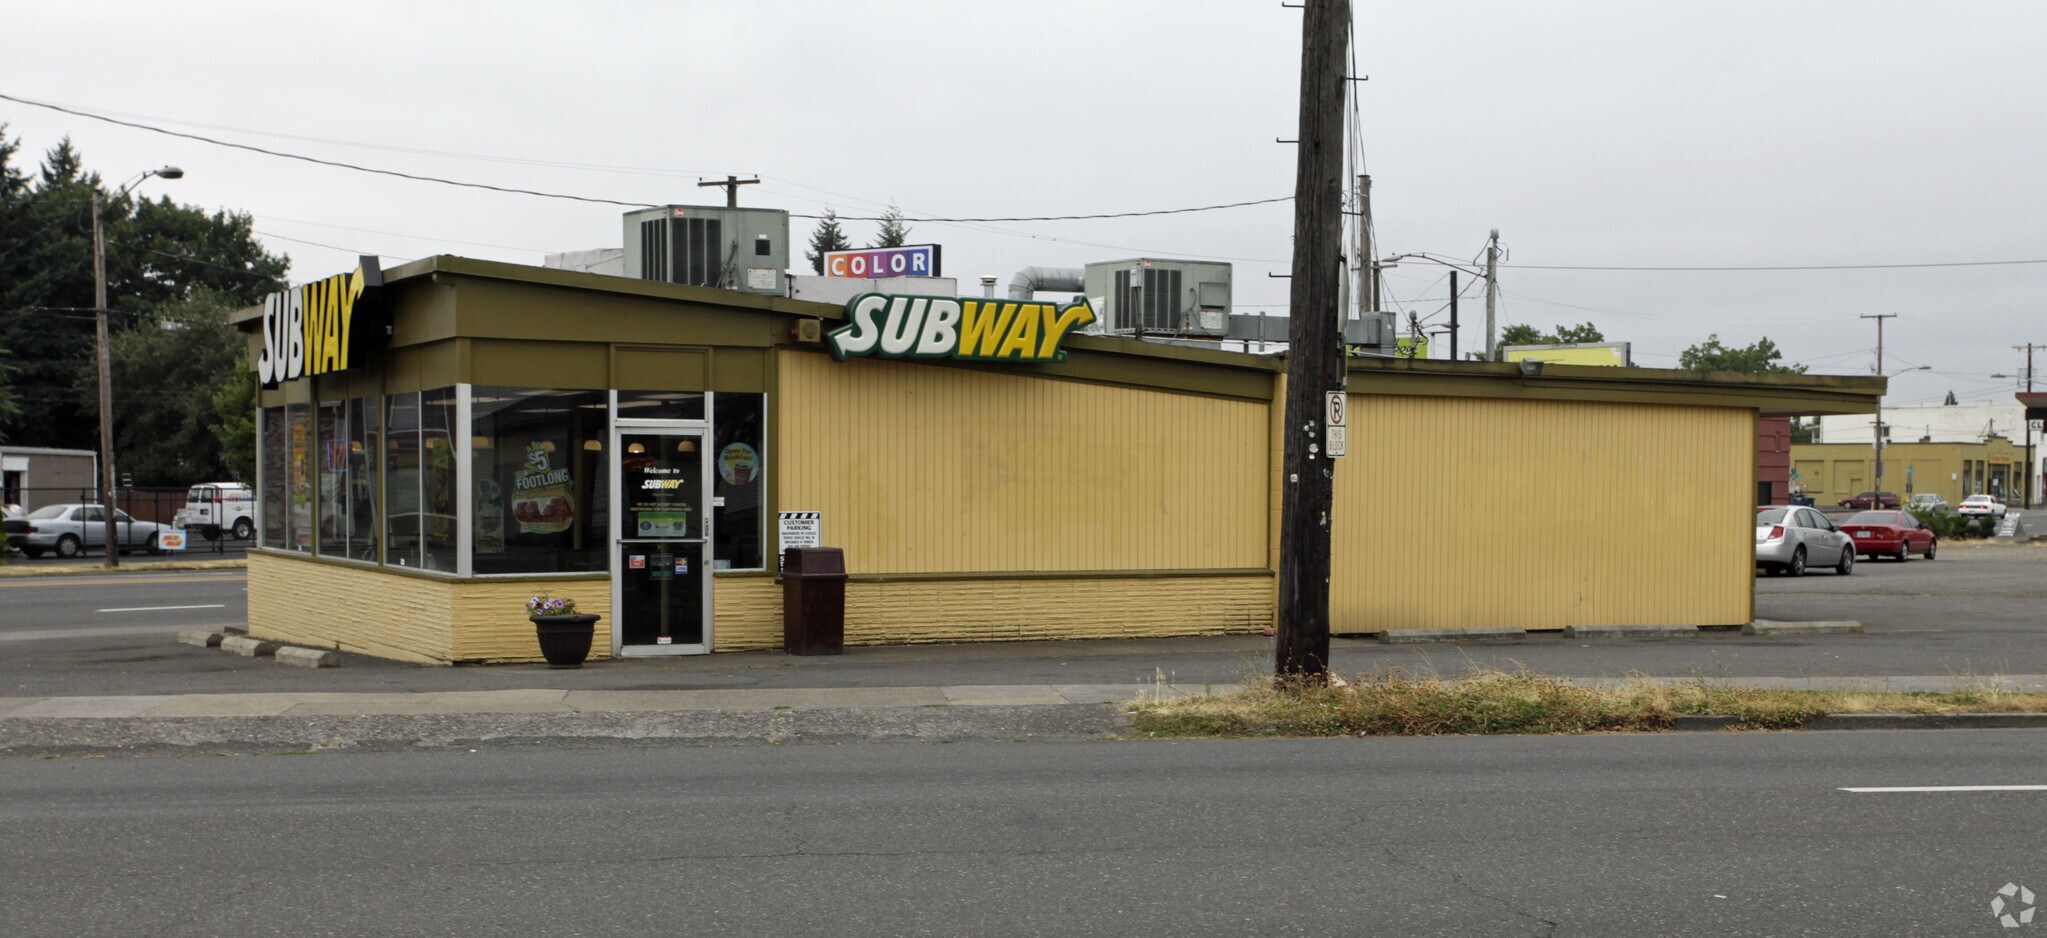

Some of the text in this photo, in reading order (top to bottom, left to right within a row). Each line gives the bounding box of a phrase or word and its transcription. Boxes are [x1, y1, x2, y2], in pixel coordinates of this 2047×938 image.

[831, 252, 926, 277] COLOR
[258, 264, 365, 387] SUBWAY
[834, 296, 1096, 360] SUBWAY
[1331, 429, 1342, 440] THIS
[1329, 440, 1344, 451] BLOCK
[529, 450, 547, 470] $5
[516, 468, 569, 490] FOOTLONG
[641, 479, 684, 489] SUBWAY
